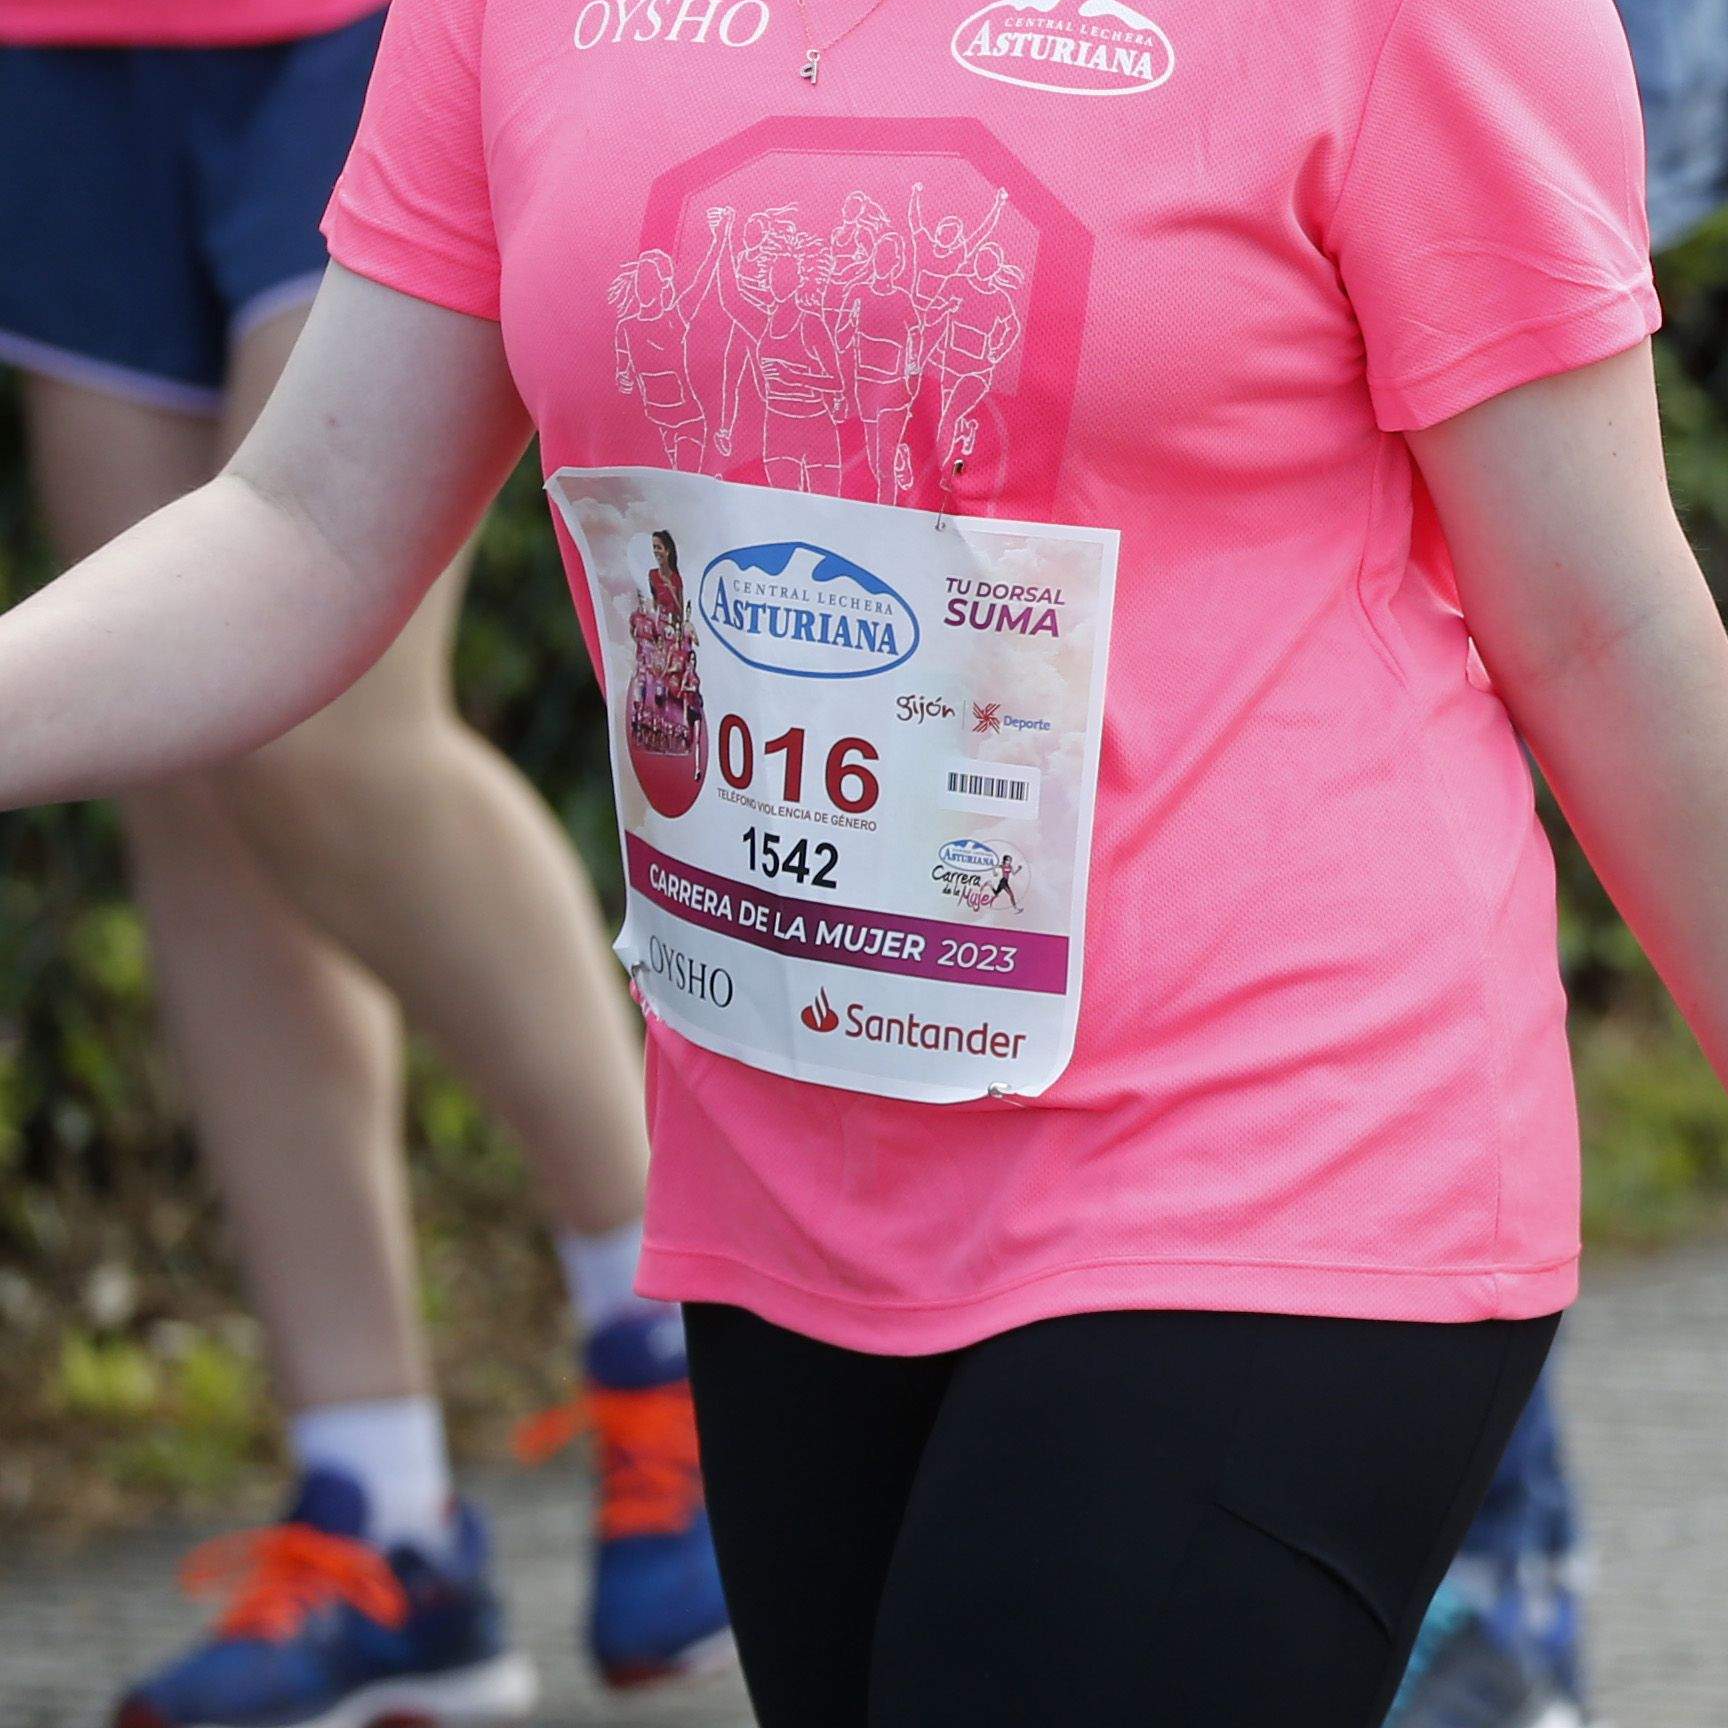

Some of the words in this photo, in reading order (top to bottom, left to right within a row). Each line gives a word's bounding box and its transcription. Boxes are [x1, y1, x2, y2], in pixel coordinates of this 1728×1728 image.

[962, 19, 1154, 81] ASTURIANA
[1004, 17, 1075, 32] CENTRAL
[1080, 24, 1154, 47] LECHERA
[733, 579, 810, 602] CENTRAL
[818, 592, 894, 616] LECHERA
[946, 577, 972, 595] TU
[976, 582, 1066, 605] DORSAL
[711, 575, 899, 656] ASTURIANA
[944, 598, 1060, 638] SUMA
[896, 694, 956, 724] gijón
[1003, 715, 1051, 731] Deporte
[718, 713, 880, 814] 016
[757, 802, 812, 820] VIOLENCIA
[814, 812, 828, 824] DE
[831, 814, 877, 832] GÉNERO
[743, 826, 839, 889] 1542
[931, 864, 981, 888] Carrera
[649, 863, 733, 922] CARRERA
[738, 902, 767, 932] DE
[773, 912, 807, 943] LA
[815, 920, 925, 961] MUJER
[937, 939, 1017, 973] 2023
[649, 934, 734, 1009] OYSHO
[845, 1003, 1027, 1060] Santander
